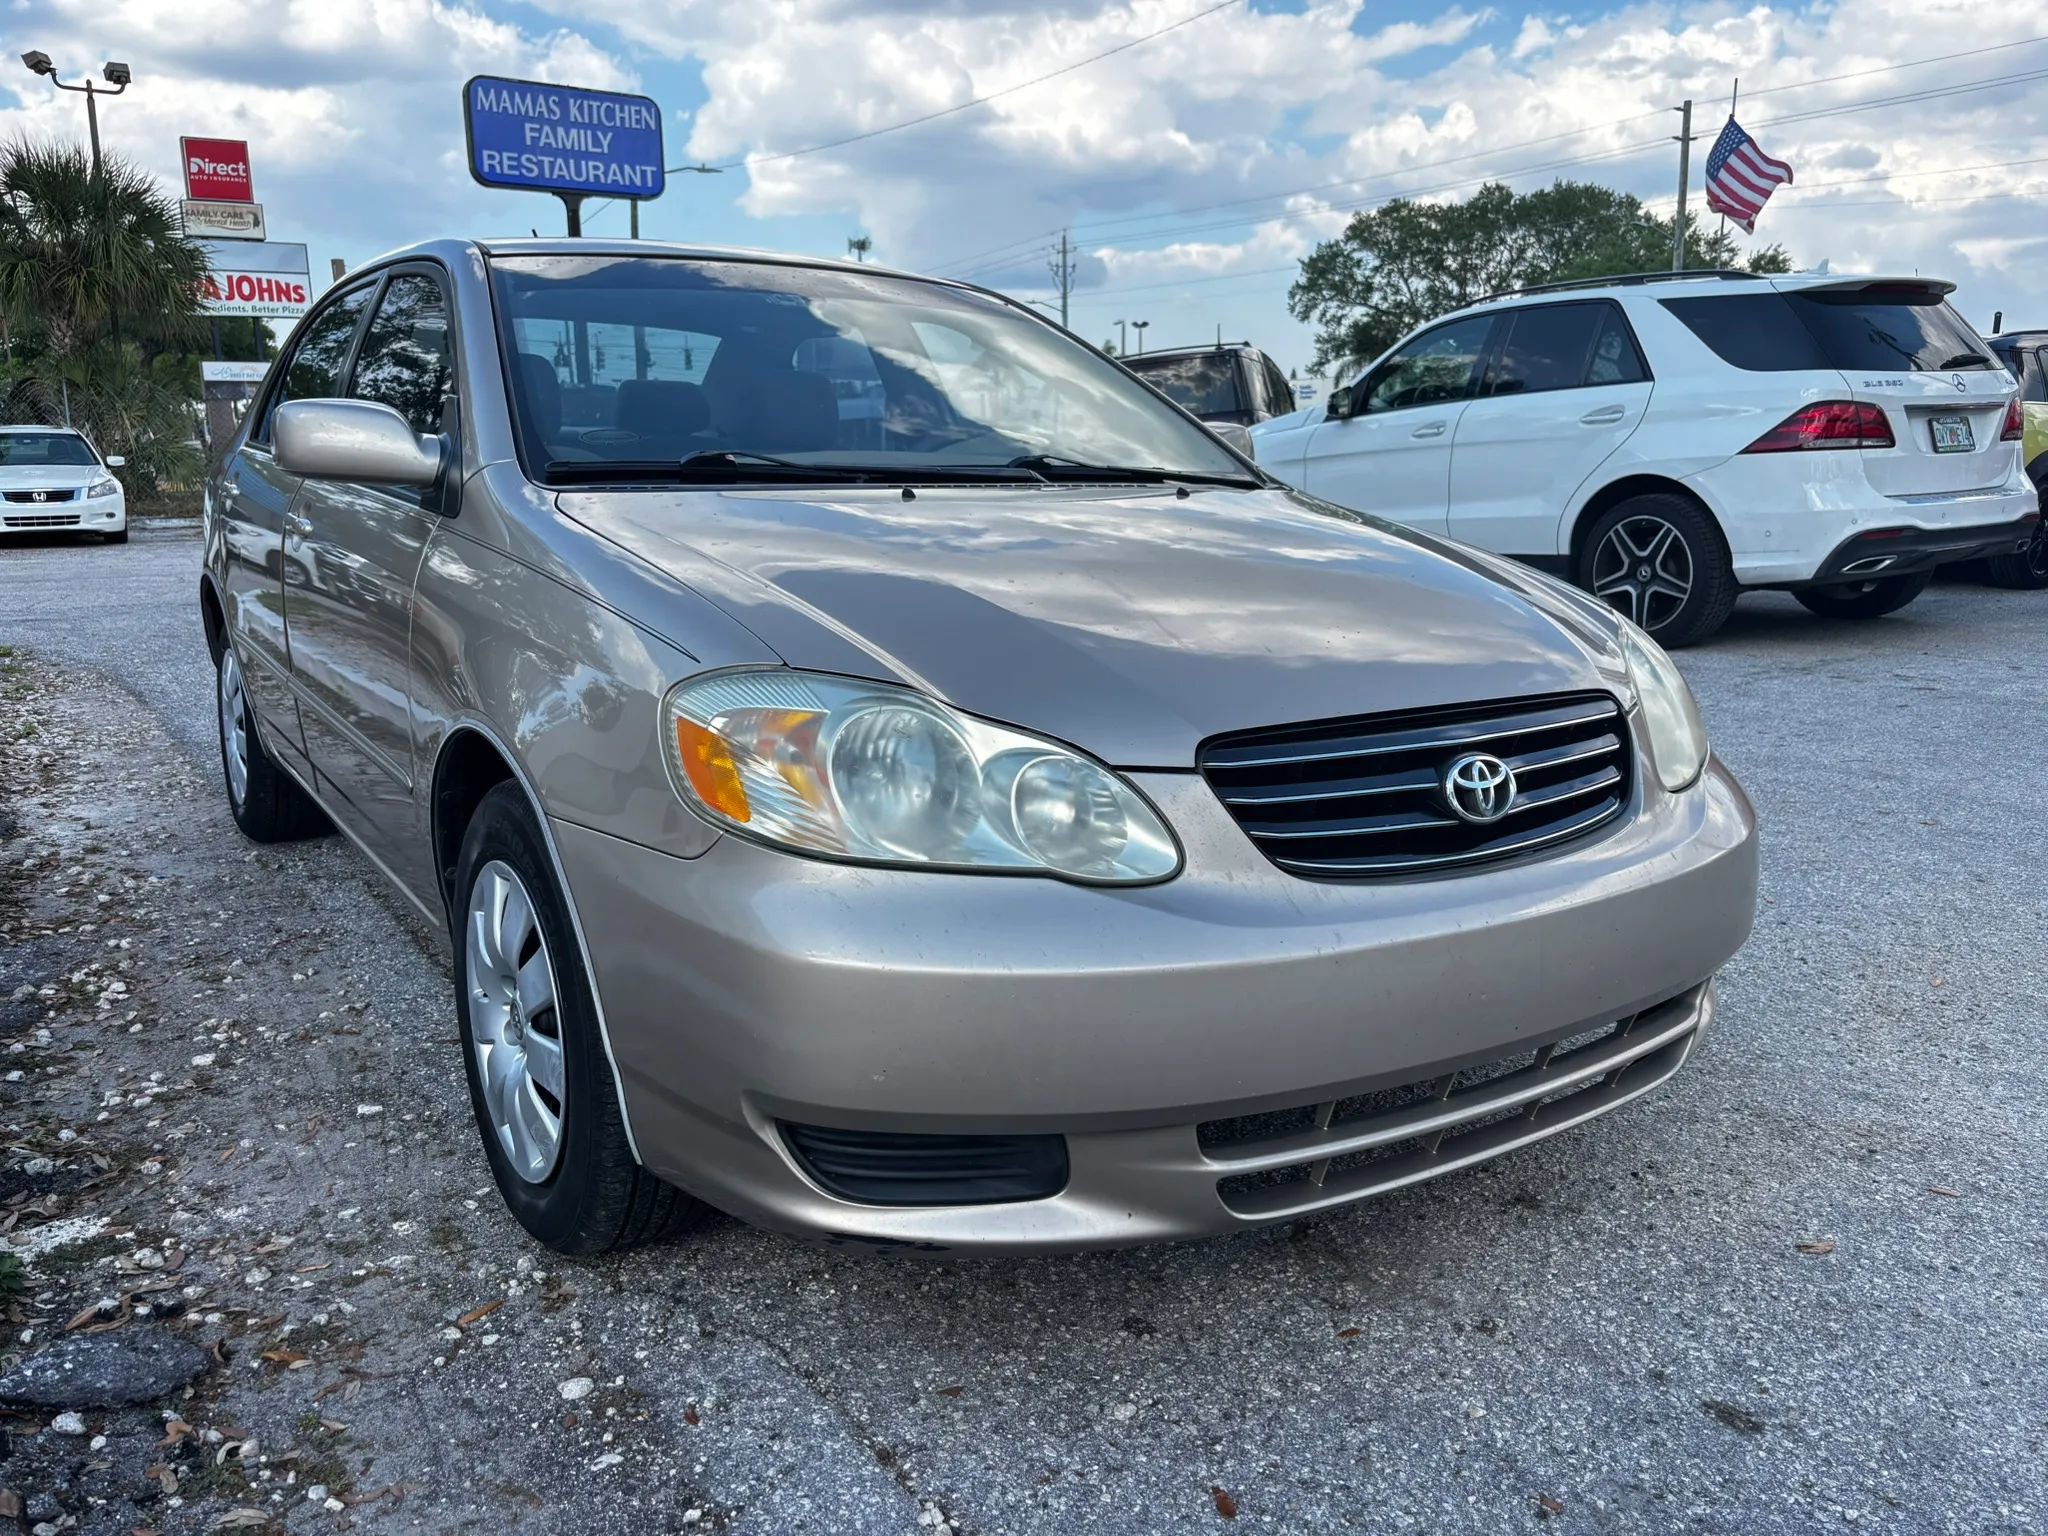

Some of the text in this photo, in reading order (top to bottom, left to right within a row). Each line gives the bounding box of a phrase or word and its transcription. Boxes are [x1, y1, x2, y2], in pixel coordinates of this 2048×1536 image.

[476, 87, 657, 130] MAMAS KITCHEN
[524, 122, 613, 154] FAMILY
[190, 157, 247, 176] Direct
[482, 150, 657, 188] RESTAURANT
[185, 209, 245, 219] FAMILY CARE
[224, 274, 306, 304] JOHNS
[251, 304, 279, 314] Better
[281, 306, 306, 315] Pizza
